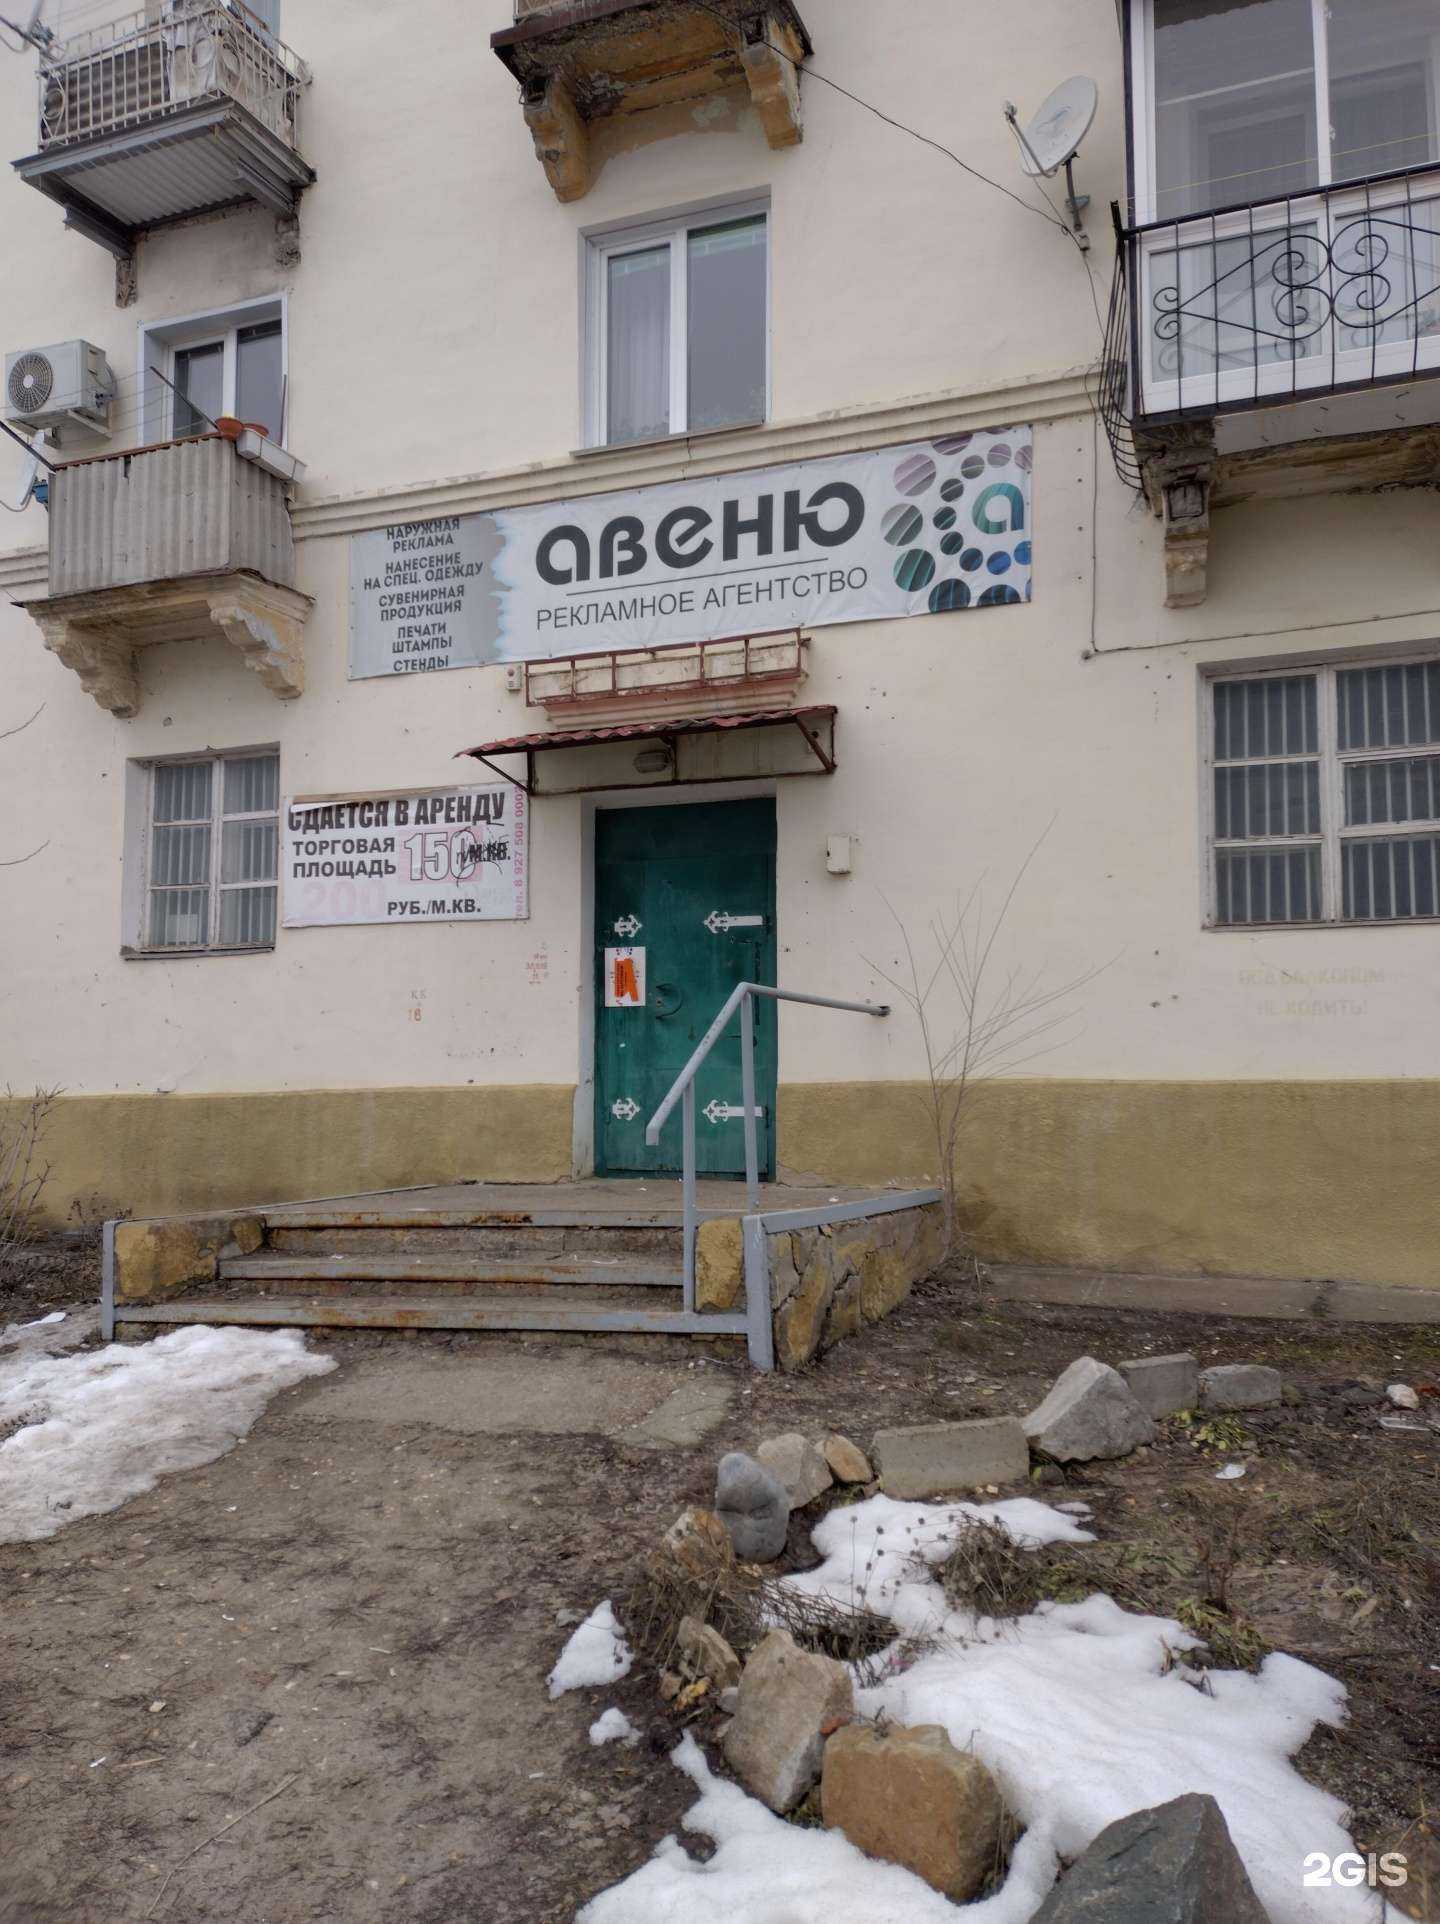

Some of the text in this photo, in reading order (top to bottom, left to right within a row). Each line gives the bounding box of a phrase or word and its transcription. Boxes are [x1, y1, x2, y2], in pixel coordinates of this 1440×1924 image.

[387, 518, 460, 540] НАРУЖНАЯ
[393, 534, 454, 553] РЕКЛАМА
[386, 552, 461, 574] НАНЕСЕНИЕ
[364, 561, 483, 590] НА СПЕЦ. ОДЕЖДУ
[379, 585, 465, 607] СУВЕНИРНАЯ
[536, 566, 867, 630] РЕКЛАМНОЕ АГЕНТСТВО
[380, 600, 462, 621] ПРОДУКЦИЯ
[397, 622, 446, 639] ПЕЧАТИ
[392, 636, 452, 653] ШТАМПЫ
[393, 655, 449, 672] СТЕНДЫ
[395, 800, 409, 826] В
[415, 792, 505, 826] АРЕНДУ
[293, 837, 396, 857] ТОРГОВАЯ
[404, 830, 477, 881] 150
[293, 860, 397, 880] ПЛОЩАДЬ
[513, 851, 524, 875] 927
[387, 899, 481, 916] РУБ./М.КВ.
